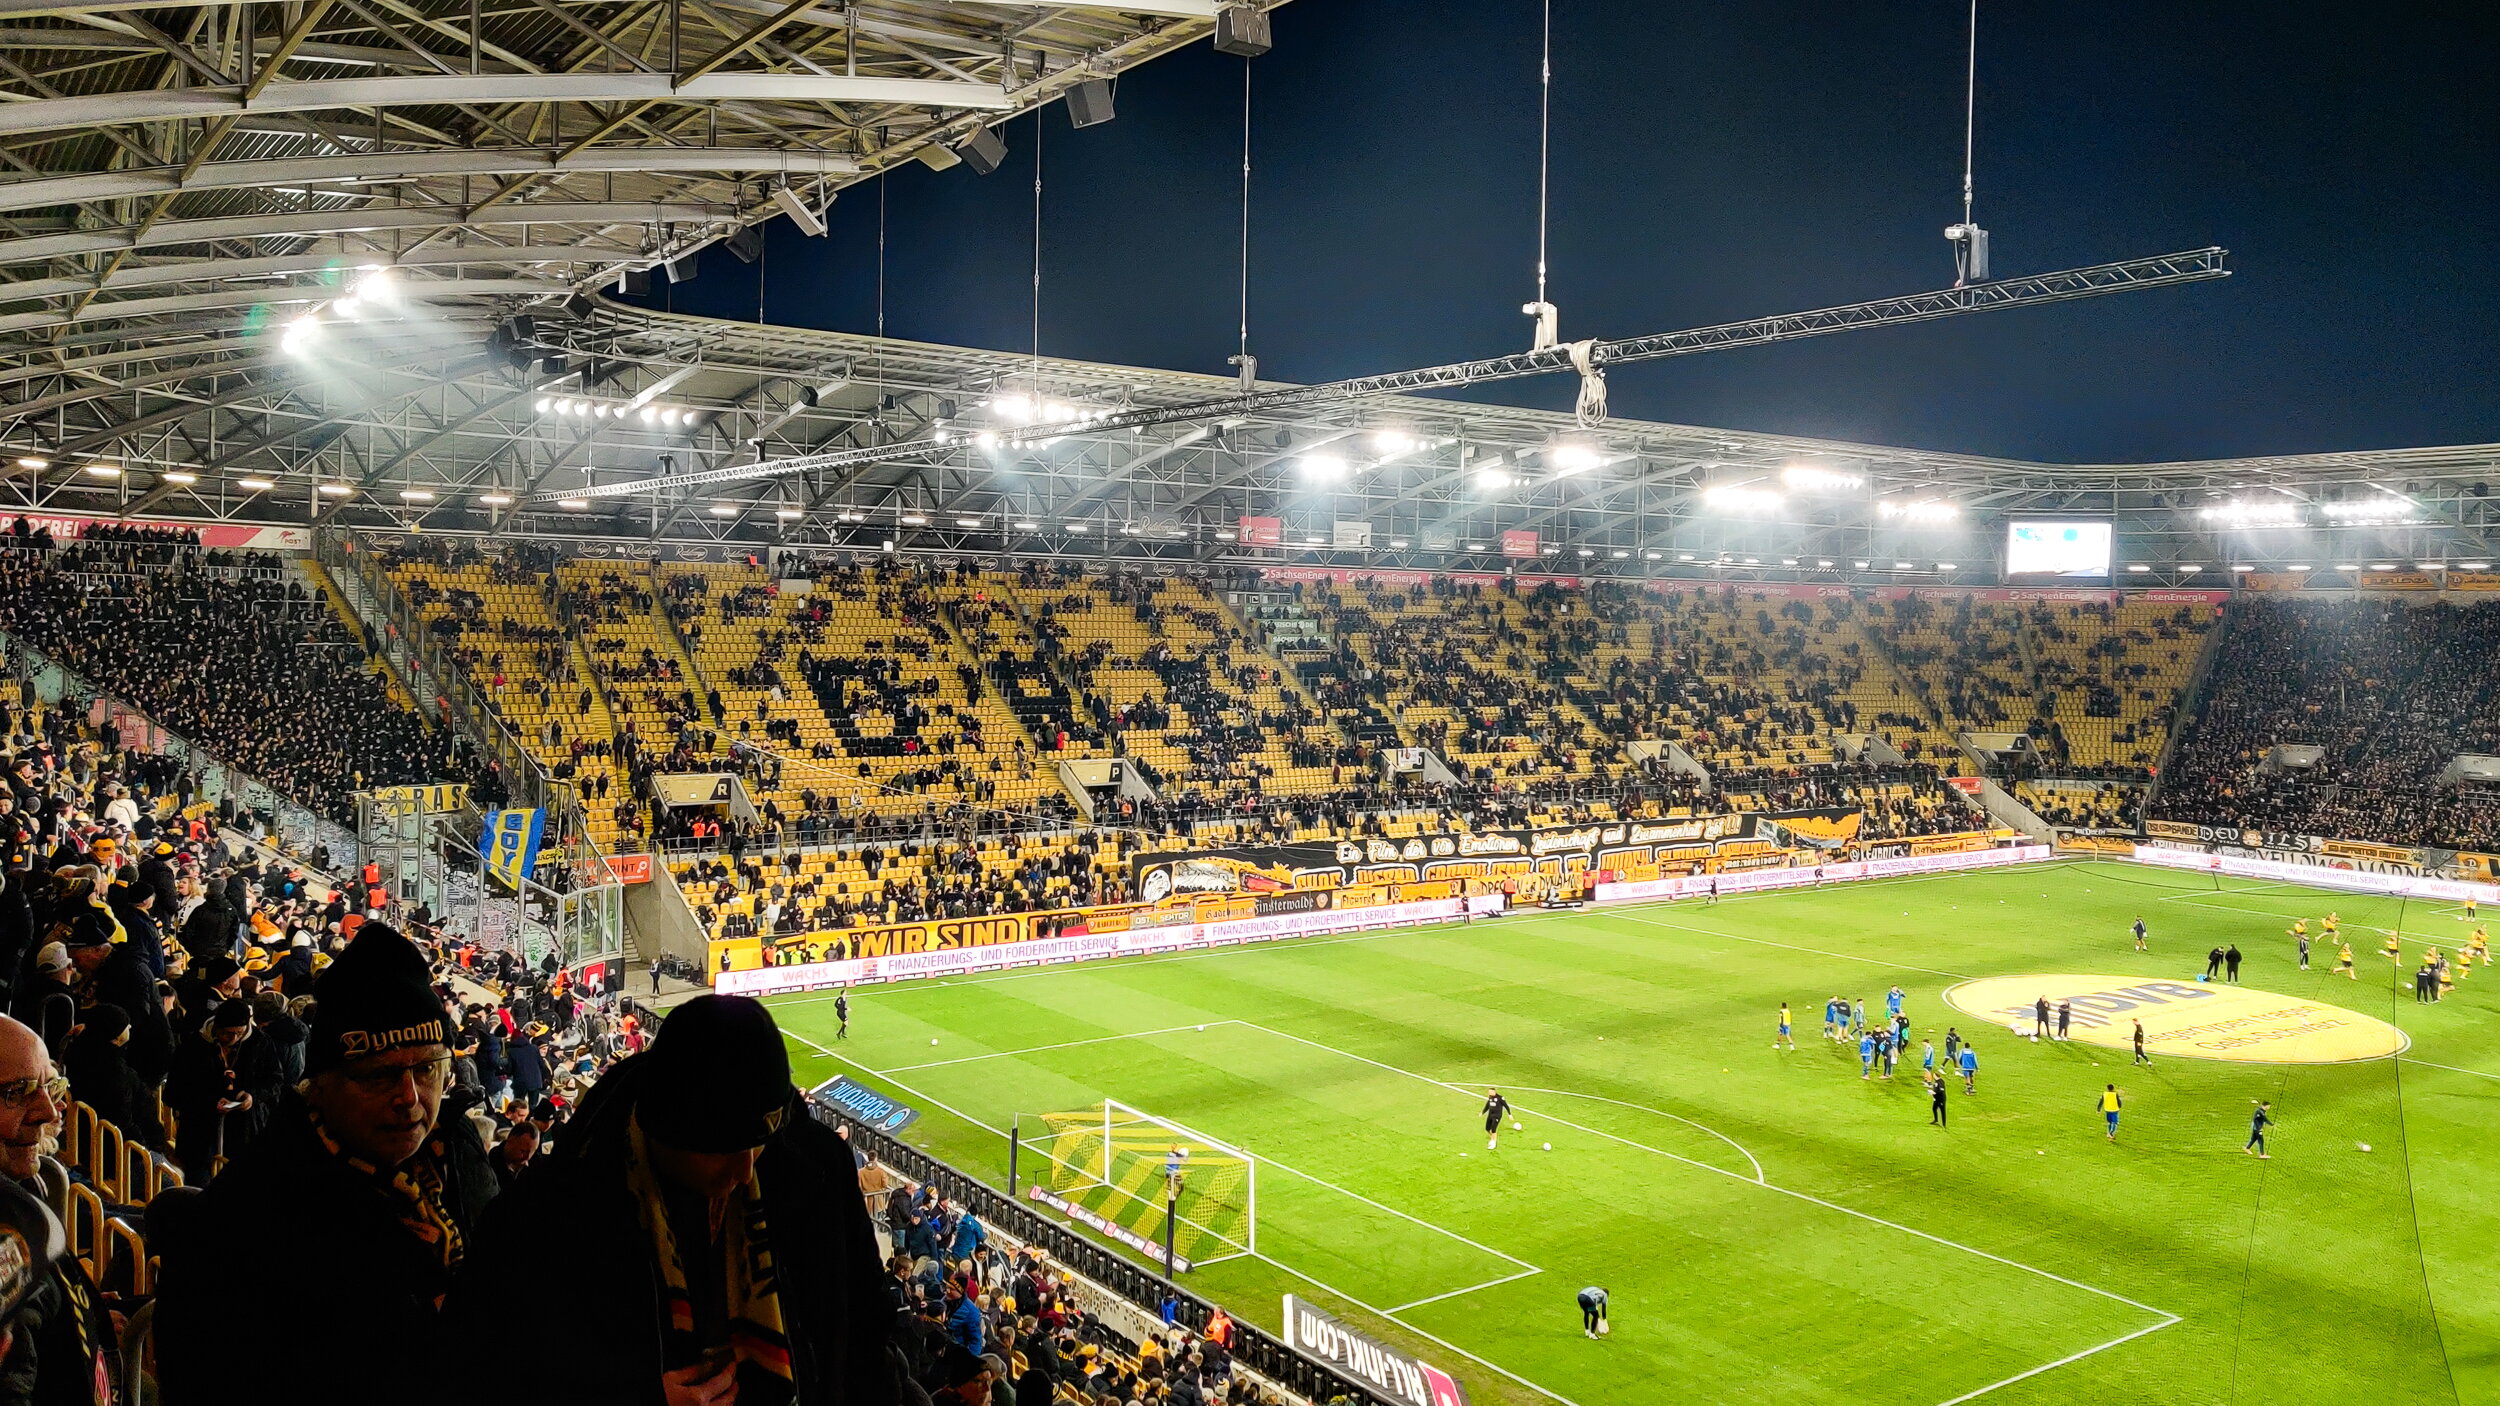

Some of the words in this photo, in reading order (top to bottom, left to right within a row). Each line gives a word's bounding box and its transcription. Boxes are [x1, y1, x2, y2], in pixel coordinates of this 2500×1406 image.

[2017, 739, 2023, 748] L
[1662, 747, 1668, 756] N
[1112, 767, 1120, 778] P
[717, 783, 728, 796] R
[1254, 895, 1315, 915] Finsterwalde
[1404, 905, 1434, 916] WACHS
[1135, 916, 1151, 926] OST
[1130, 931, 1166, 944] WACHS
[1285, 917, 1303, 930] UND
[850, 926, 926, 959] WIR
[938, 918, 1020, 951] SIND
[782, 967, 828, 983] WACHS
[888, 951, 977, 972] FINANZIERUNGS-
[980, 948, 1002, 962] UND
